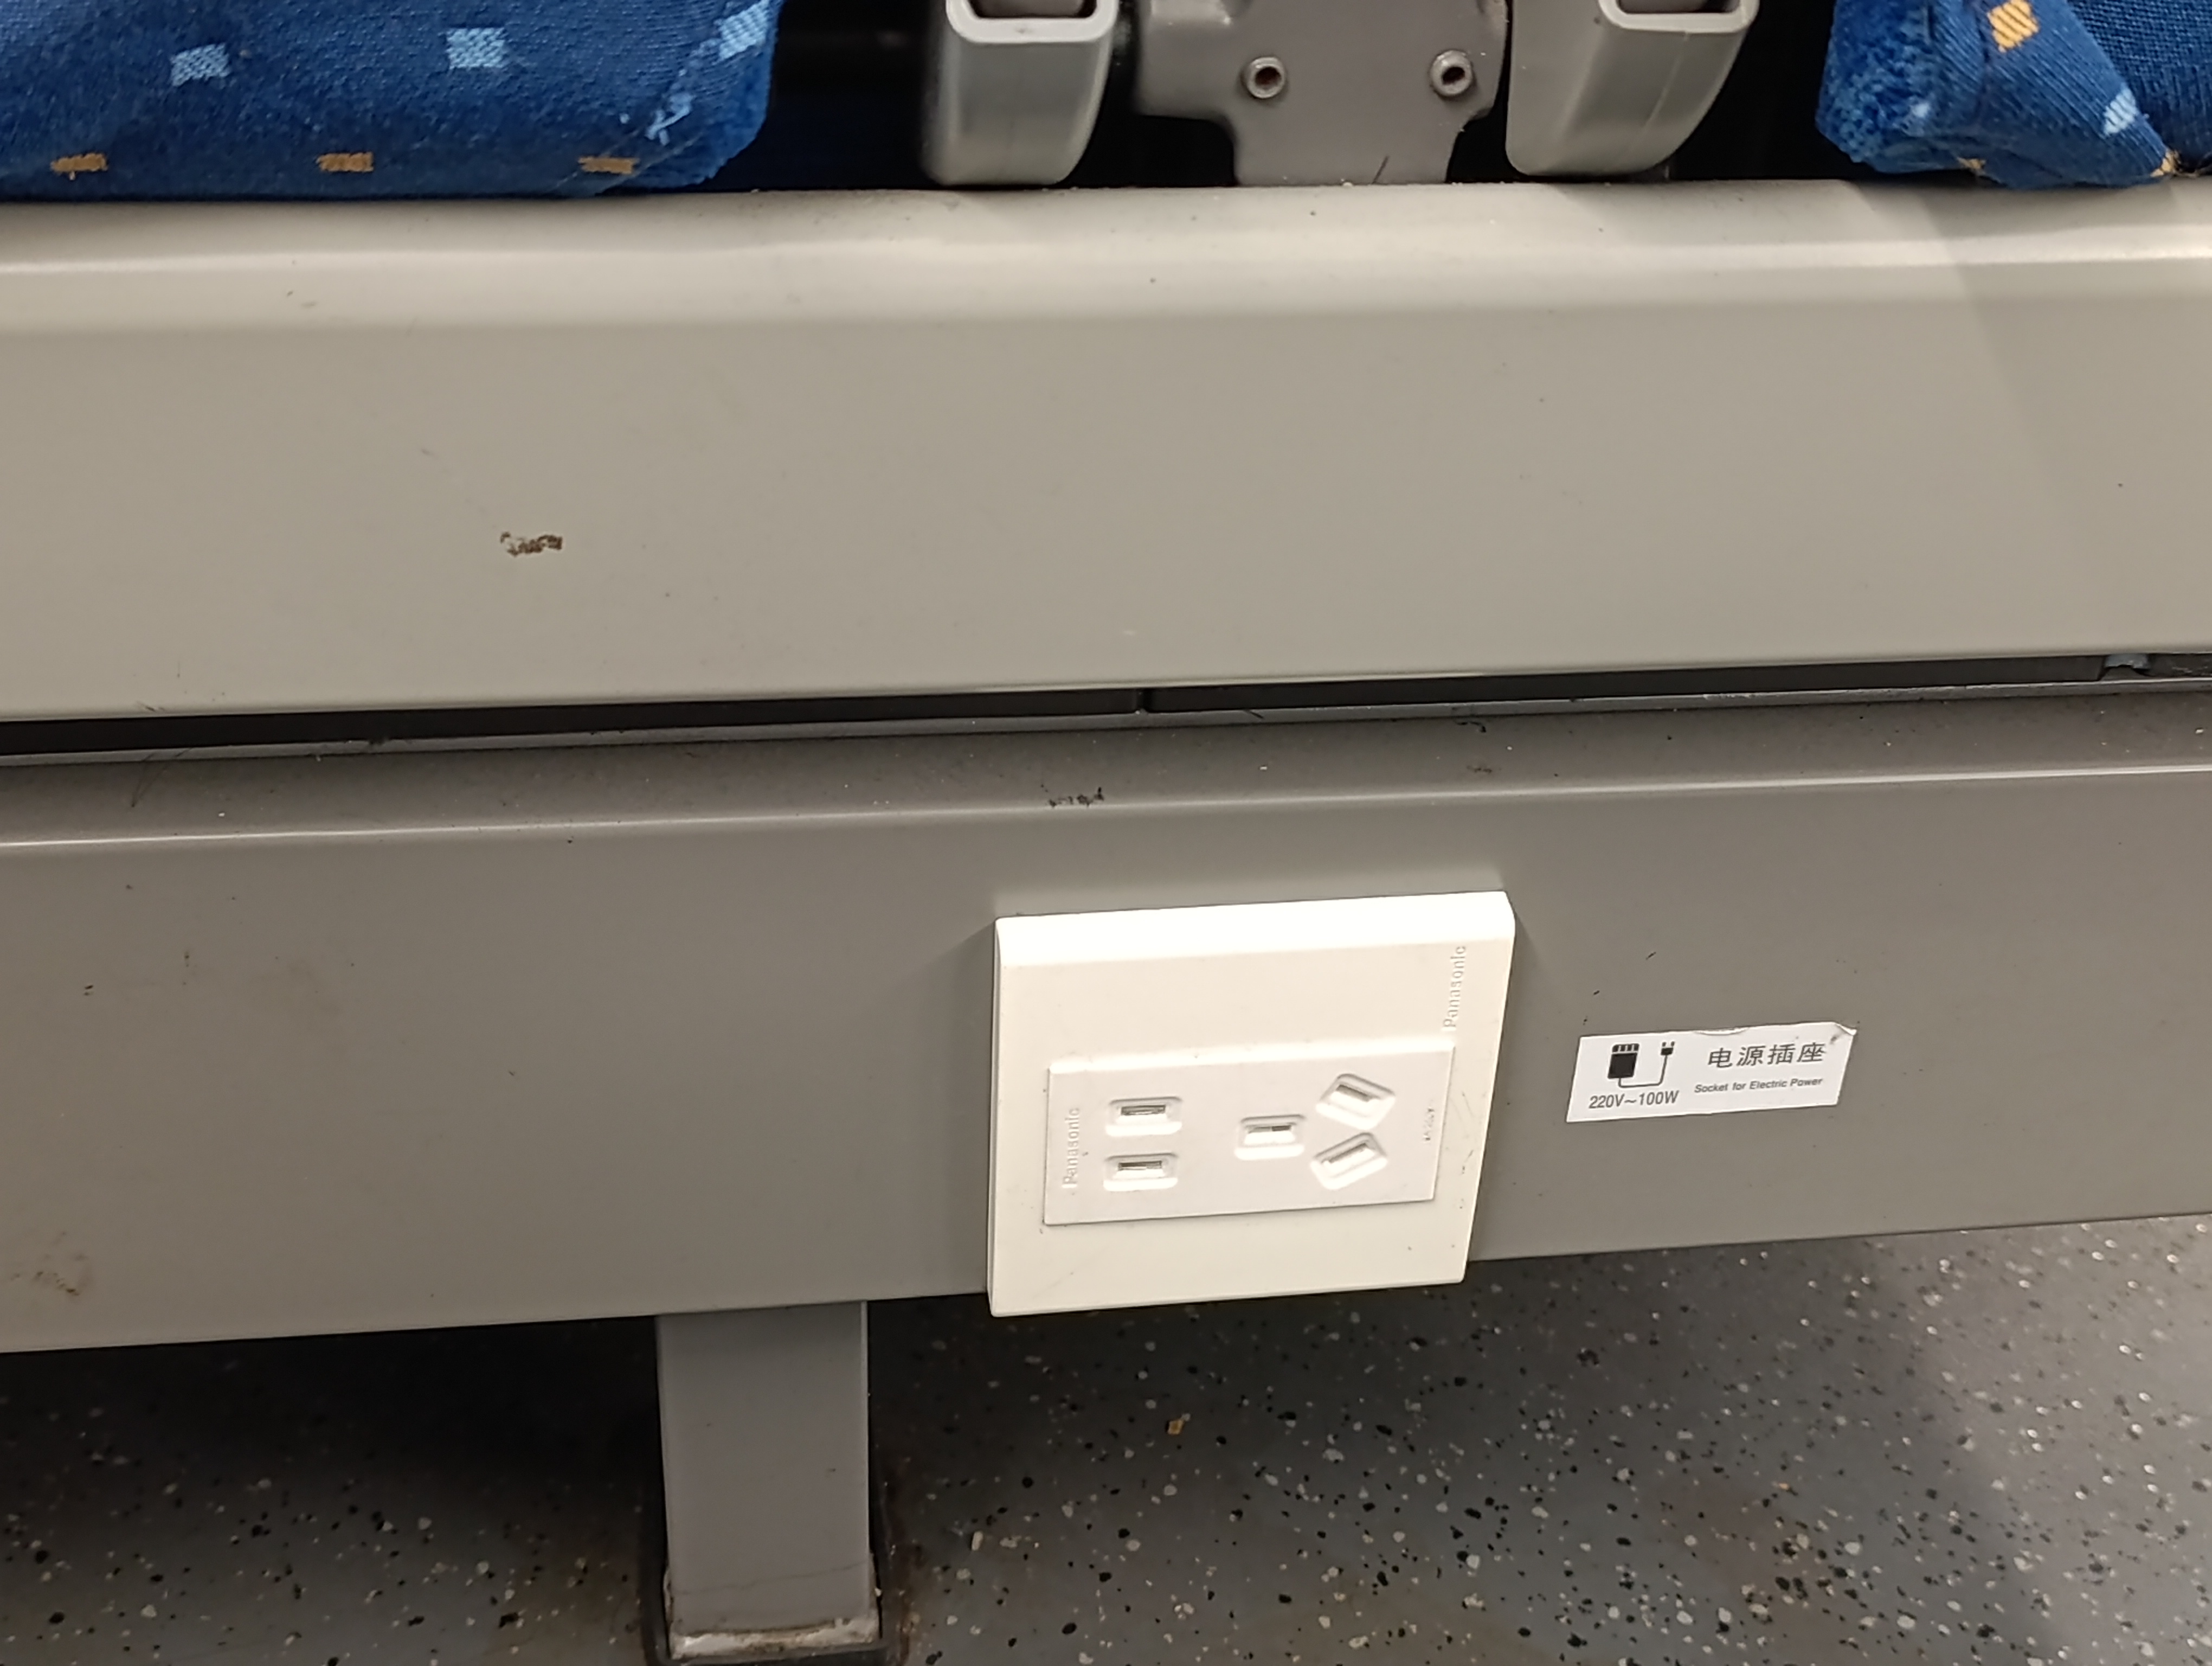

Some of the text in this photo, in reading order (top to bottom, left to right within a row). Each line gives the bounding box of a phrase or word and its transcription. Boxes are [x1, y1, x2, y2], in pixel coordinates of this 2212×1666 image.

[1442, 946, 1466, 1031] Panasonic
[1707, 1042, 1827, 1068] 电源插座
[1694, 1078, 1823, 1093] Socket for Electric Power
[1062, 1107, 1079, 1188] Panasonic
